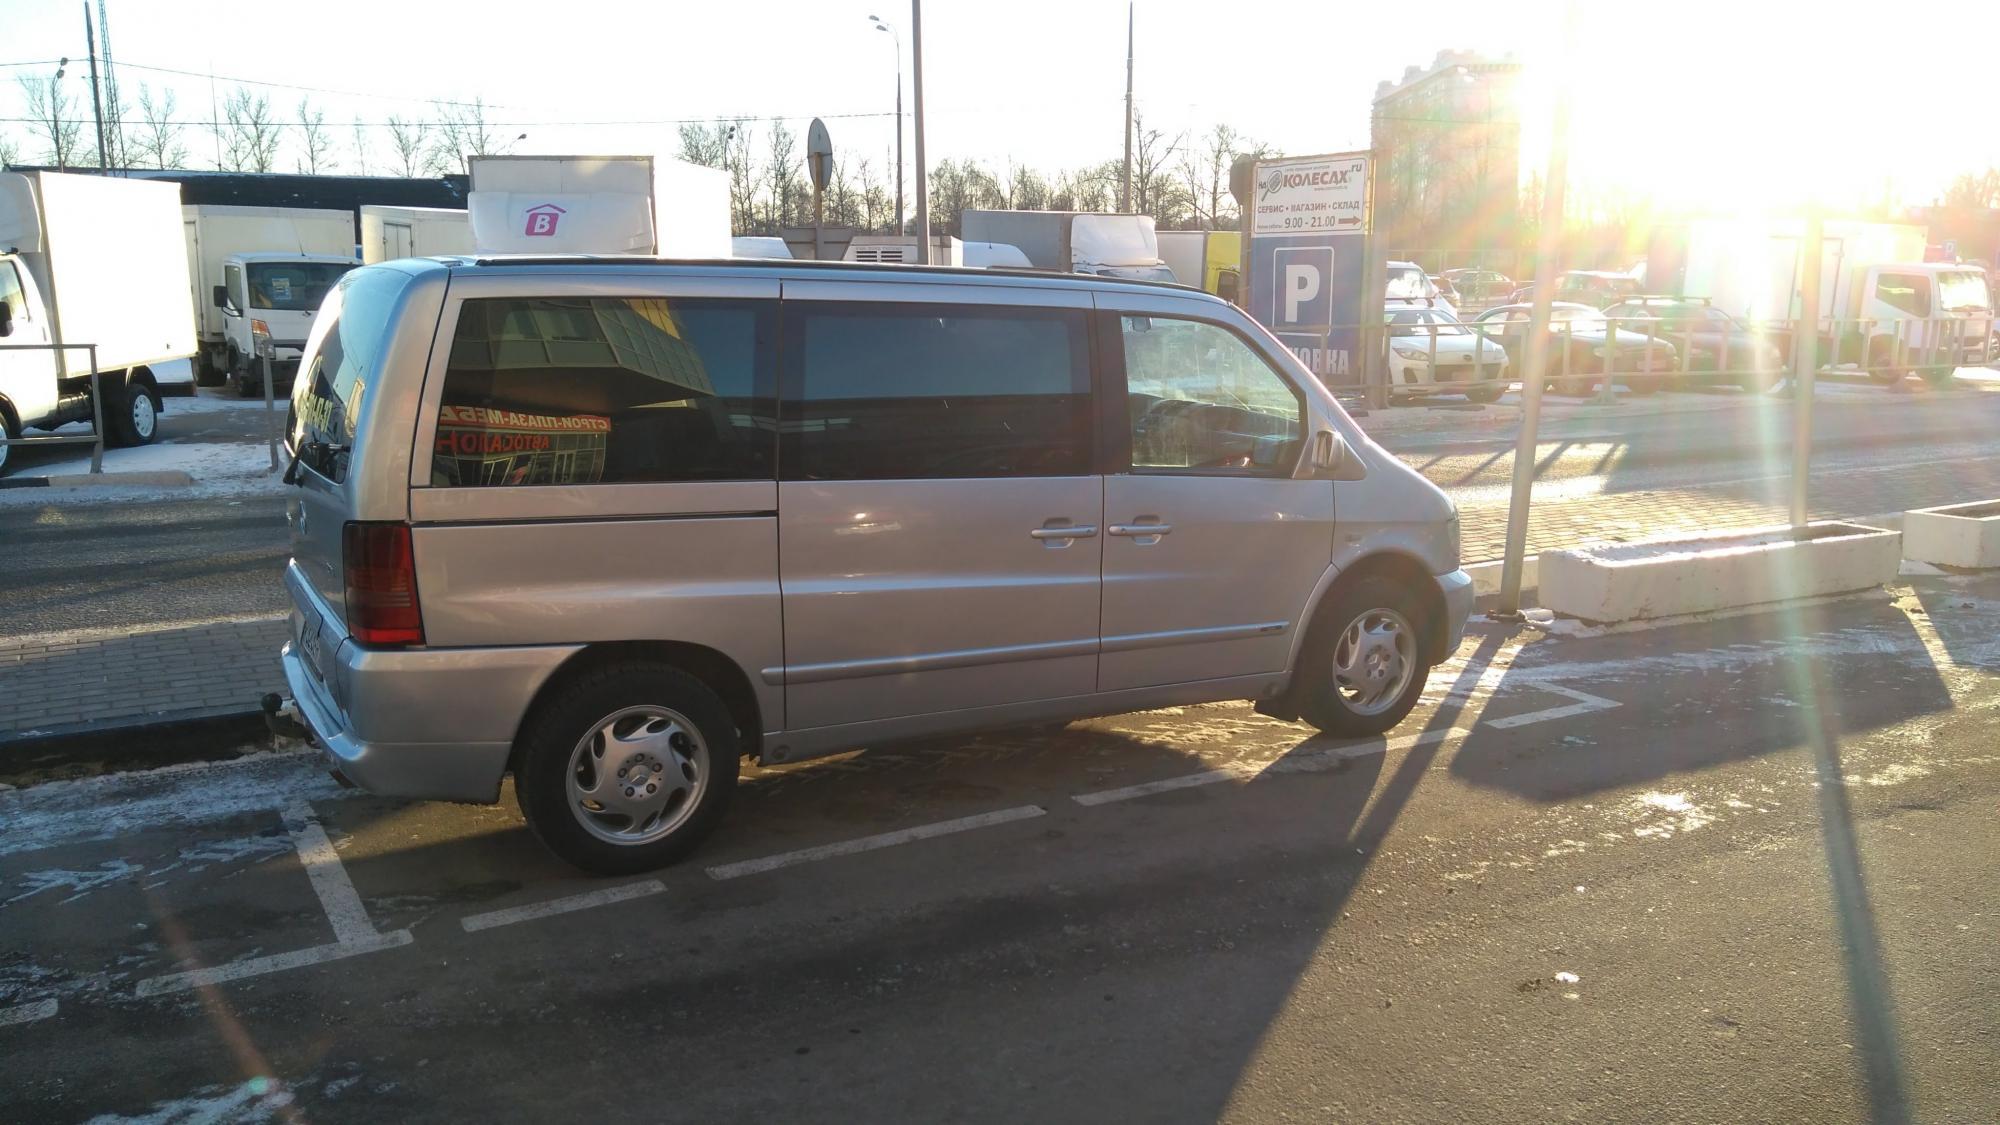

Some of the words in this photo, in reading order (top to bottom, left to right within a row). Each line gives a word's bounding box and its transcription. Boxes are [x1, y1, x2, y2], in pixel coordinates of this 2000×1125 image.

[1258, 205, 1284, 214] СЕРВИС
[1290, 203, 1327, 212] МАГАЗИН
[1332, 201, 1360, 210] СКЛАД
[1284, 217, 1303, 229] 9.00
[1311, 216, 1336, 228] 21.00
[1285, 264, 1320, 323] P
[1288, 347, 1349, 375] ОВКА
